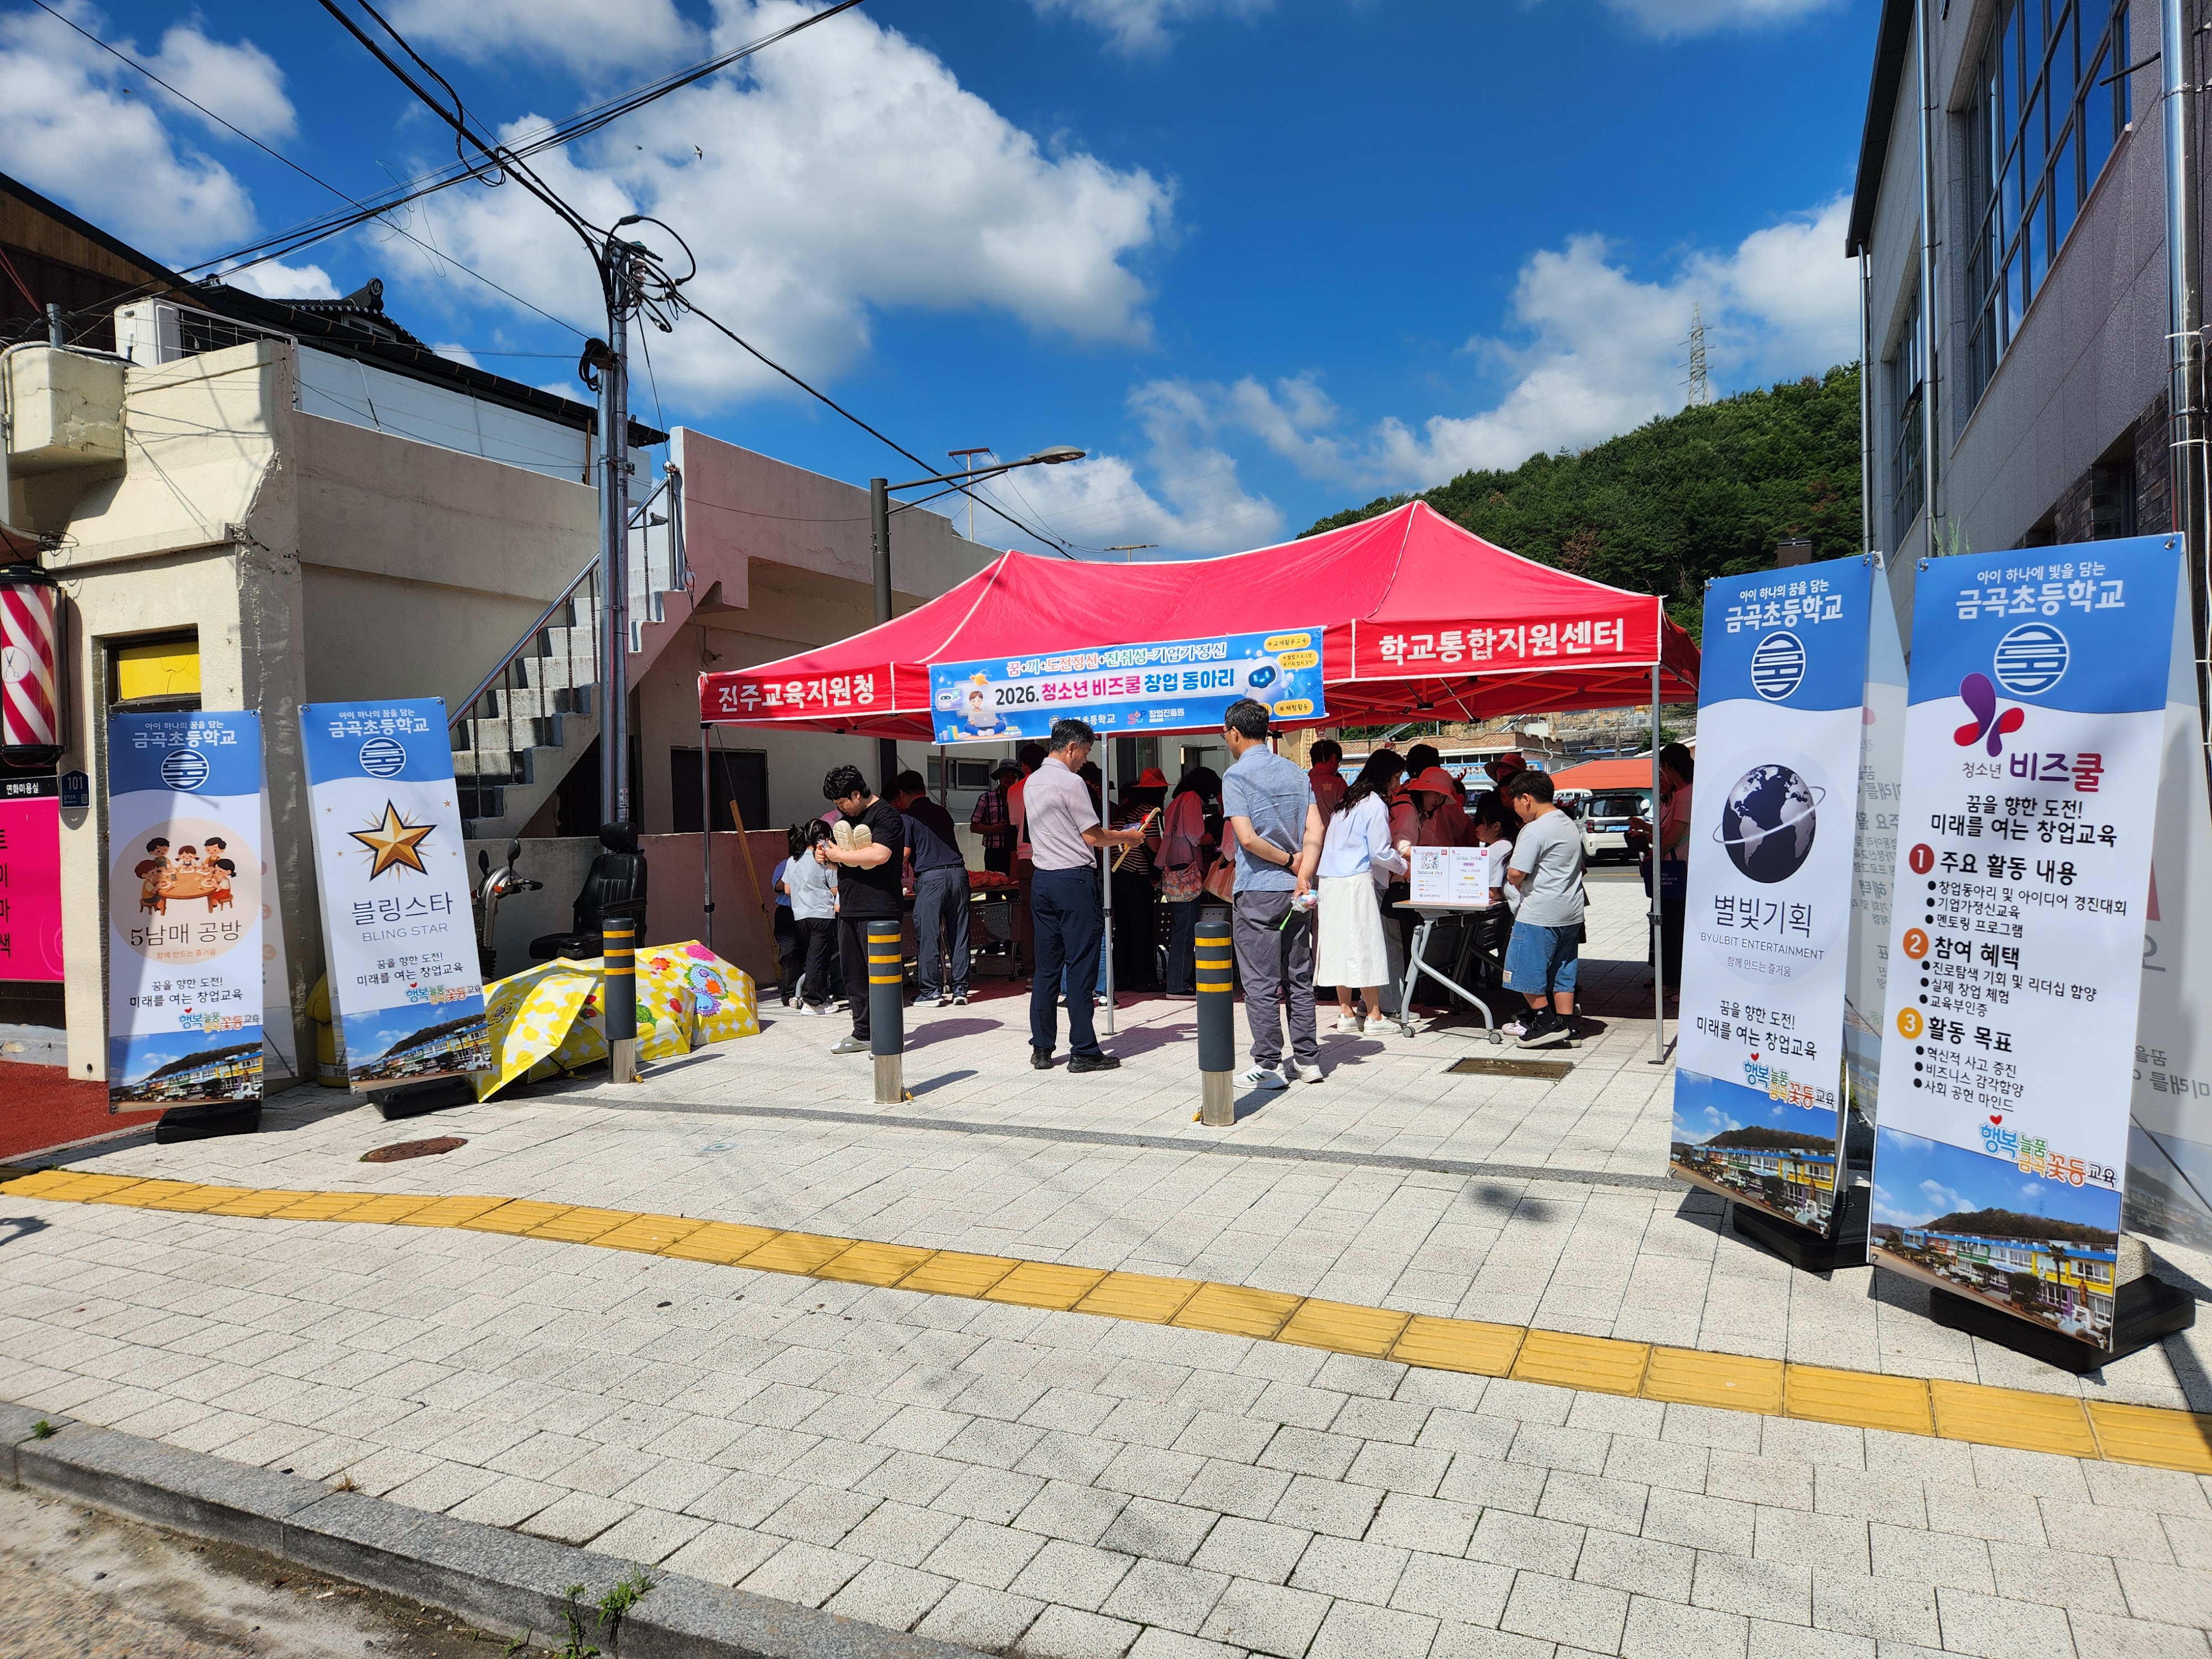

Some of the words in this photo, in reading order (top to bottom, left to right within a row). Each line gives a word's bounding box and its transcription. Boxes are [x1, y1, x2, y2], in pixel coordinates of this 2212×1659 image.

[1977, 570, 2001, 585] 아이
[2006, 566, 2044, 583] 하나에
[2049, 564, 2074, 580] 빛을
[2079, 561, 2105, 577] 담는
[1740, 589, 1756, 602] 아이
[1760, 584, 1786, 599] 하나의
[1788, 582, 1807, 596] 꿈을
[1810, 579, 1829, 592] 담는
[1955, 580, 2125, 620] 금곡초등학교
[1725, 594, 1843, 633] 금곡초등학교
[1379, 618, 1623, 665] 학교통합지원센터
[719, 674, 874, 712] 진주교육지원청
[995, 686, 1039, 706] 2026.
[1041, 680, 1088, 701] 청소년
[1092, 675, 1140, 696] 비즈쿨
[1145, 673, 1177, 692] 창업
[1183, 669, 1234, 690] 동아리
[164, 722, 187, 730] 하나의
[190, 721, 206, 729] 꿈을
[208, 721, 223, 729] 담는
[328, 717, 429, 738] 금곡초등학교
[1065, 714, 1115, 726] 초등학교
[132, 731, 237, 749] 금곡초등학교
[68, 776, 82, 790] 101
[1962, 763, 2001, 779] 청소년
[2010, 753, 2104, 792] 비즈쿨
[7, 782, 39, 795] 연화미용실
[1966, 795, 1998, 814] 꿈을
[2005, 796, 2038, 816] 향한
[2043, 800, 2083, 820] 도전!
[1931, 814, 1984, 837] 미래를
[1991, 818, 2029, 841] 여는
[2036, 820, 2117, 848] 창업교육
[1918, 849, 1924, 868] 1
[1940, 851, 1978, 874] 주요
[1987, 854, 2027, 880] 활동
[2036, 859, 2077, 885] 내용
[352, 891, 453, 925] 블링스타
[1938, 898, 2021, 920] 기업가정신교육
[1939, 880, 1997, 900] 창업동아리
[2002, 888, 2013, 902] 및
[2018, 890, 2068, 909] 아이디어
[2074, 896, 2127, 916] 경진대회
[1714, 895, 1812, 938] 별빛기획
[1937, 914, 1970, 931] 멘토링
[1975, 920, 2023, 938] 프로그램
[131, 924, 188, 946] 5남매
[198, 920, 242, 942] 공방
[363, 928, 406, 941] BLING
[411, 924, 447, 935] STAR
[1700, 932, 1739, 946] BYULBIT
[1742, 939, 1824, 960] ENTERTAINMENT
[377, 958, 395, 969] 꿈을
[400, 956, 418, 966] 향한
[422, 952, 443, 963] 도전!
[1911, 934, 1921, 953] 2
[1934, 936, 1971, 963] 참여
[1981, 942, 2020, 970] 혜택
[357, 973, 390, 985] 미래를
[395, 970, 416, 982] 여는
[421, 963, 463, 978] 창업교육
[1728, 956, 1742, 968] 함께
[1744, 959, 1766, 972] 만드는
[1768, 963, 1791, 977] 즐거움
[153, 981, 172, 991] 꿈을
[176, 979, 196, 989] 향한
[200, 977, 222, 987] 도전!
[406, 988, 429, 1002] 행복
[1932, 978, 1954, 994] 실제
[1958, 983, 1981, 999] 창업
[1986, 987, 2009, 1004] 체험
[1933, 962, 1979, 981] 진로탐색
[1984, 971, 2006, 987] 기회
[2012, 974, 2023, 990] 및
[2029, 977, 2065, 997] 리더십
[2070, 984, 2097, 1001] 함양
[130, 995, 165, 1008] 미래를
[169, 993, 192, 1005] 여는
[197, 989, 243, 1003] 창업교육
[1930, 995, 1988, 1018] 교육부인증
[179, 1013, 203, 1029] 행복
[244, 1014, 260, 1023] 교육
[1720, 1000, 1740, 1018] 꿈을
[1745, 1005, 1766, 1024] 향한
[1770, 1011, 1795, 1030] 도전!
[1697, 1016, 1731, 1040] 미래를
[1736, 1026, 1760, 1046] 여는
[1765, 1032, 1817, 1061] 창업교육
[1904, 1014, 1916, 1032] 3
[1928, 1016, 1965, 1045] 활동
[1974, 1026, 2012, 1053] 목표
[1927, 1047, 1960, 1066] 혁신적
[1965, 1056, 1988, 1072] 사고
[1993, 1062, 2017, 1079] 증진
[1745, 1061, 1770, 1089] 행복
[1815, 1089, 1835, 1109] 교육
[1926, 1064, 1971, 1085] 비즈니스
[1975, 1074, 2023, 1098] 감각함양
[1924, 1080, 1947, 1097] 사회
[1951, 1086, 1974, 1102] 공헌
[1979, 1093, 2014, 1113] 마인드
[1980, 1124, 2018, 1157] 행복
[2088, 1162, 2117, 1188] 교육
